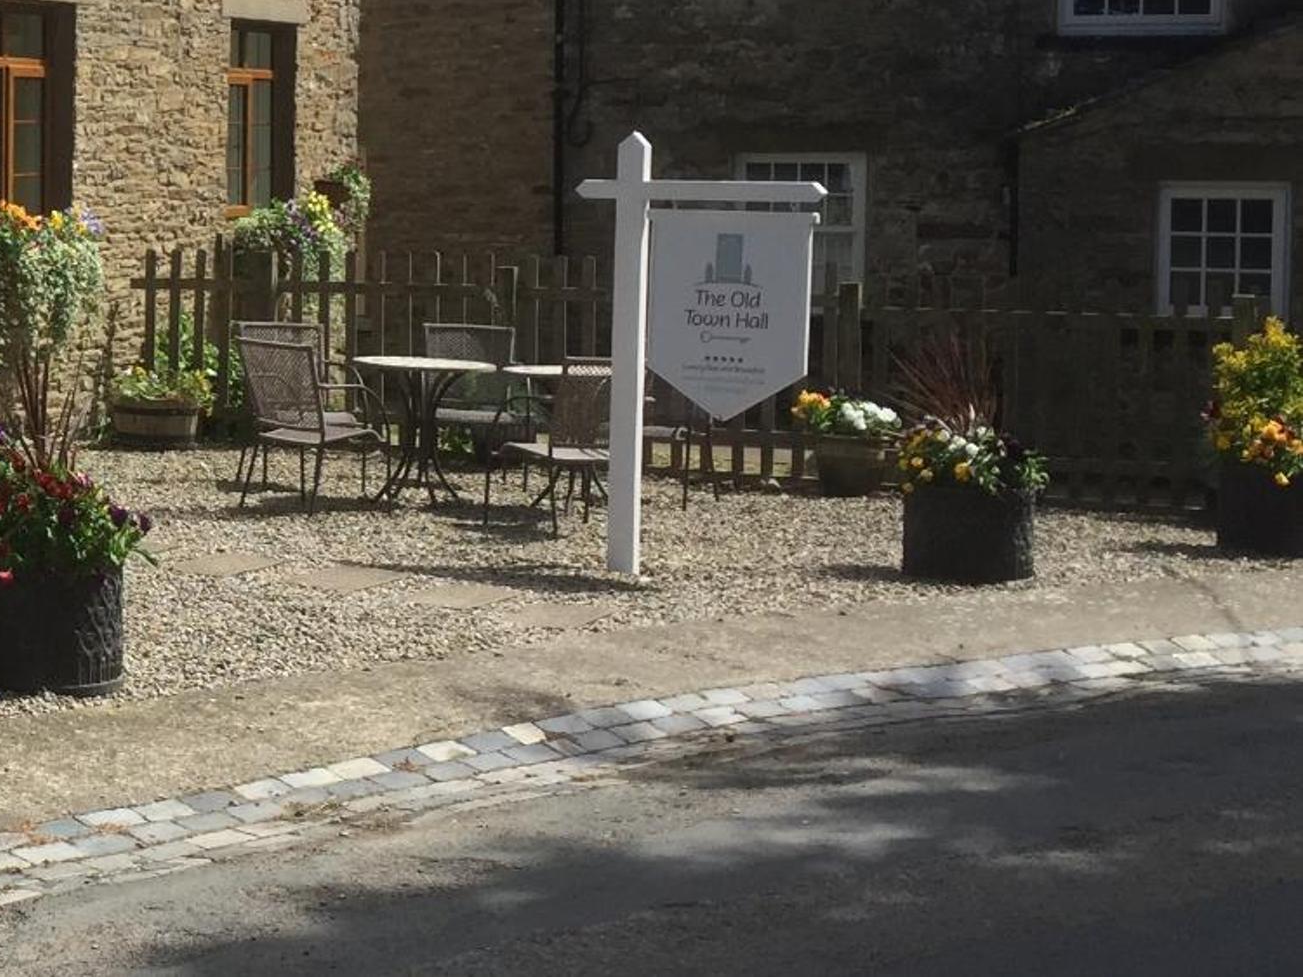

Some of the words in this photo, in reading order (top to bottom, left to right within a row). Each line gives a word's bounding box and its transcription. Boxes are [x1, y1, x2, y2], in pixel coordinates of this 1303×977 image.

[696, 290, 726, 307] The
[730, 291, 761, 308] Old
[684, 309, 730, 328] Town
[736, 312, 769, 329] Hall
